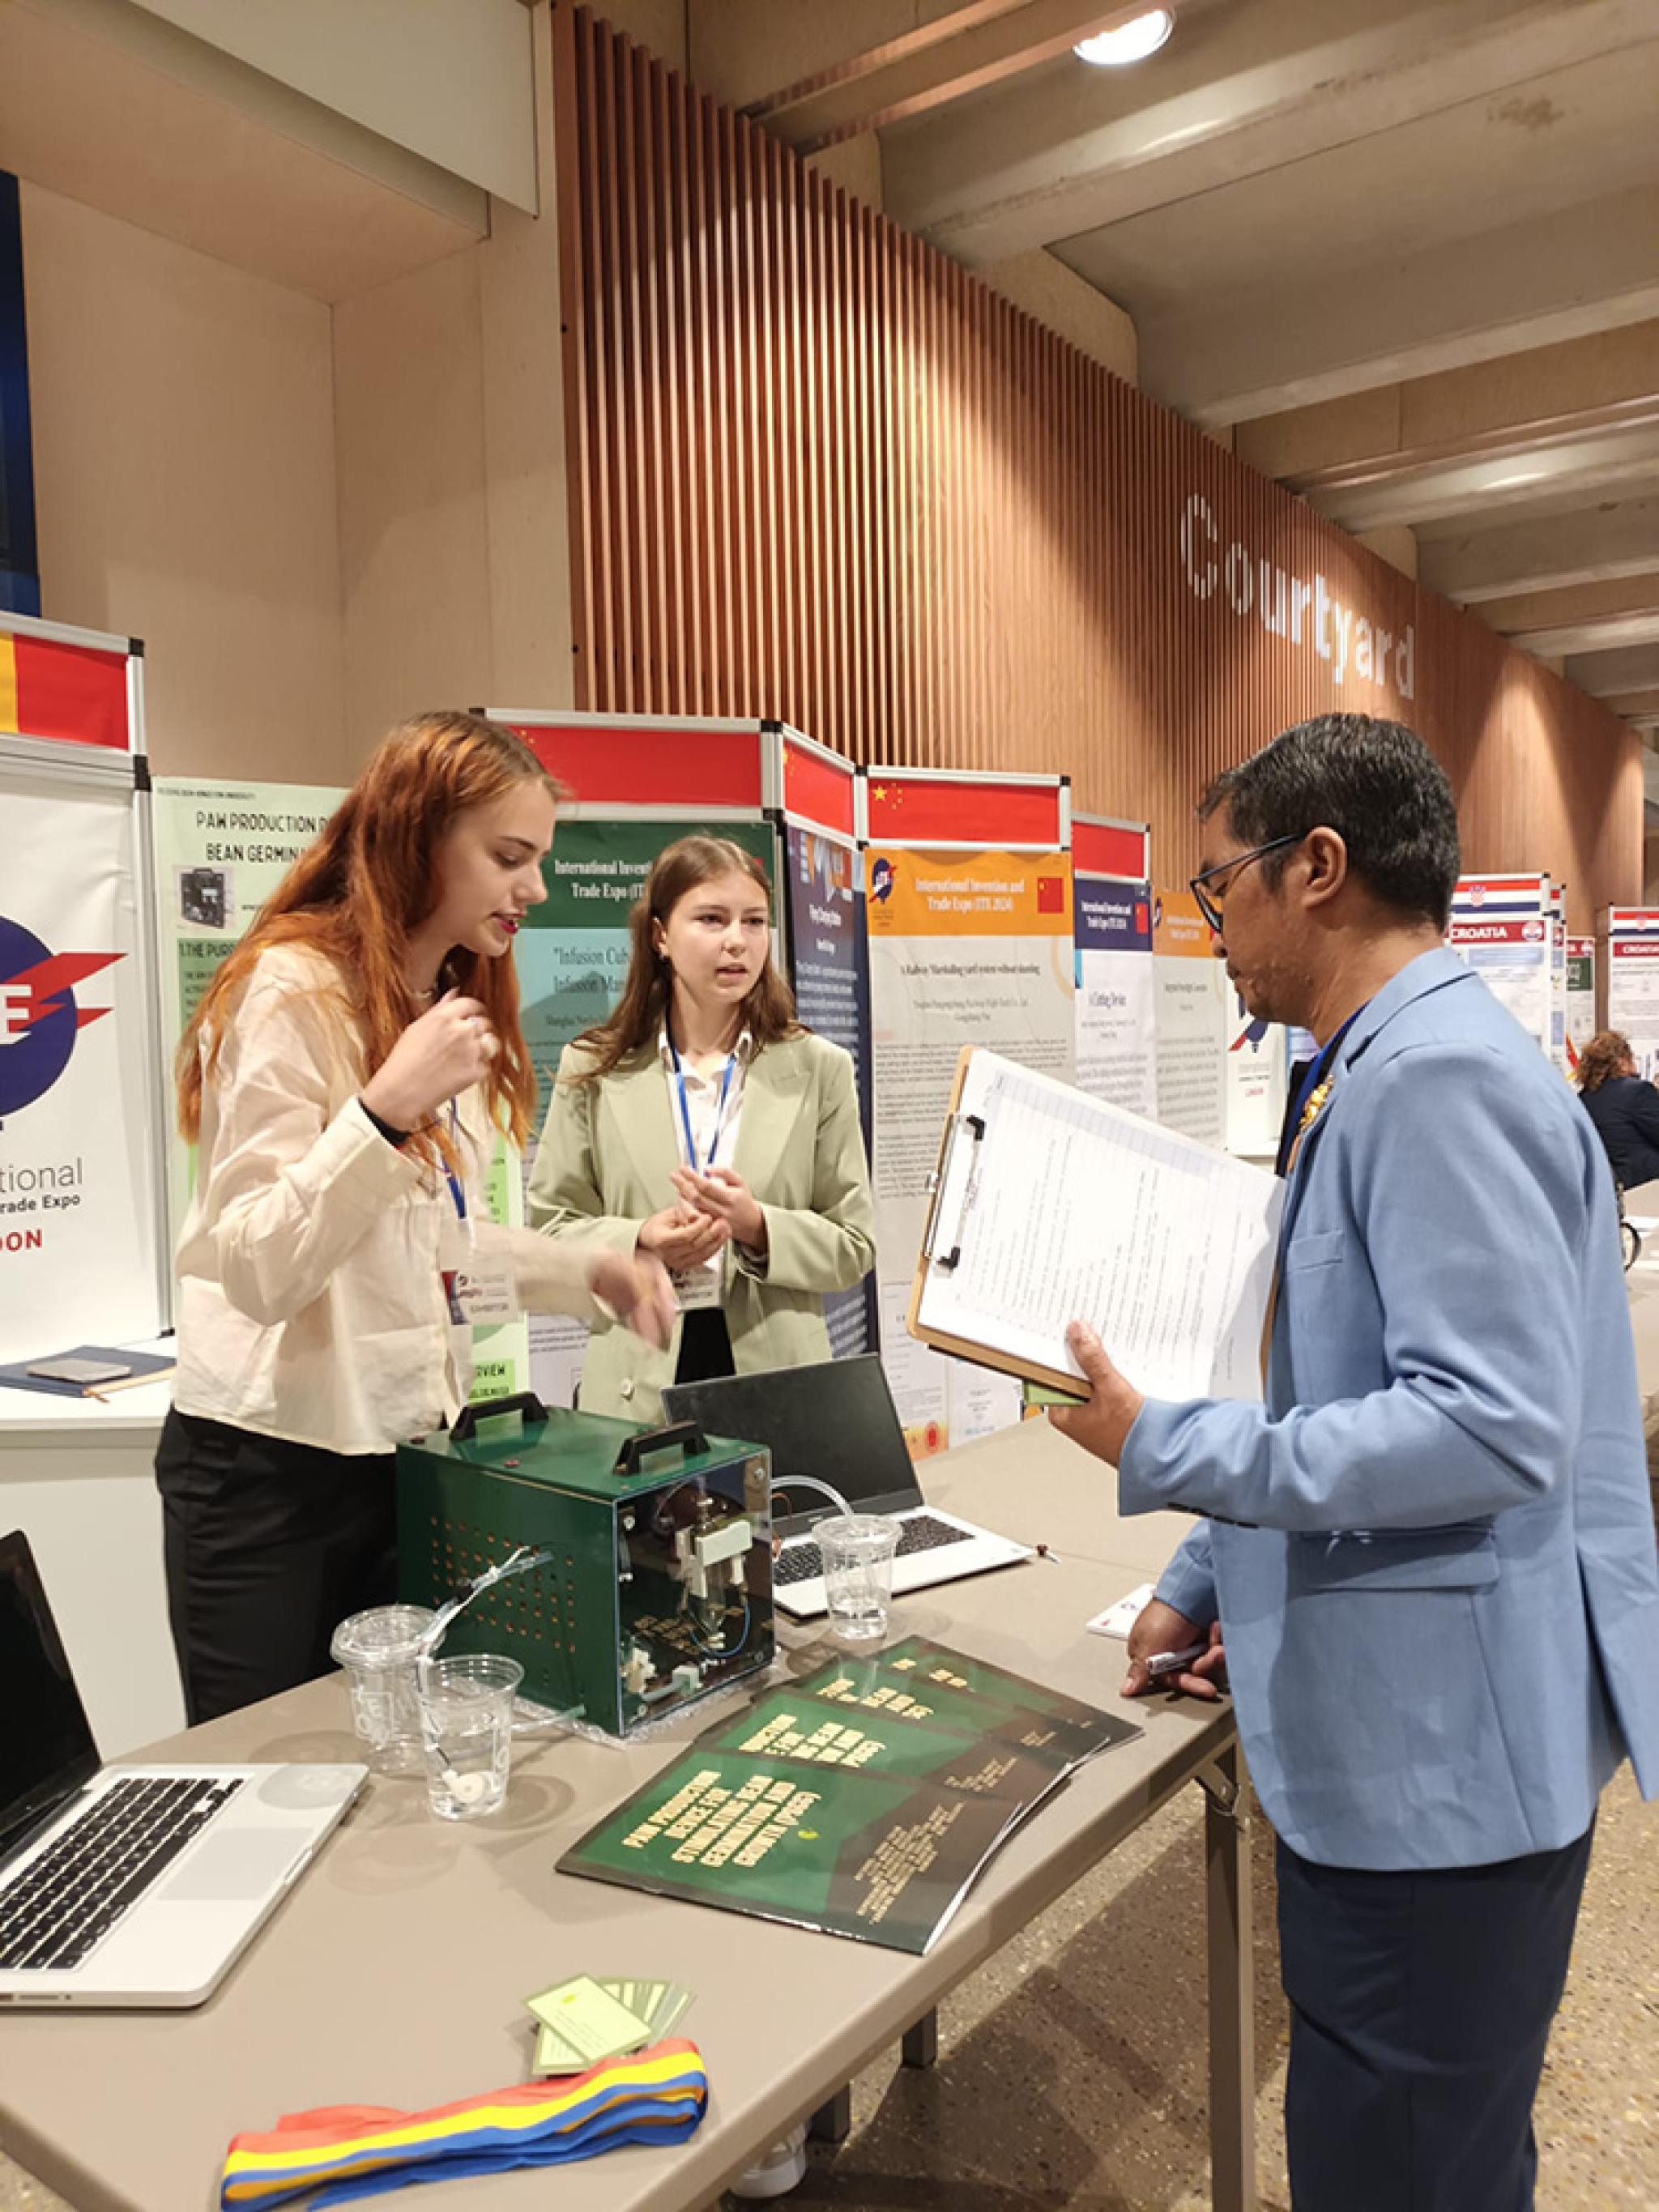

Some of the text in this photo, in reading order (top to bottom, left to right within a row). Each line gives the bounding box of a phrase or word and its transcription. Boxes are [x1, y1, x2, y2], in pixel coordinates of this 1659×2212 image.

[1180, 492, 1414, 700] Courtyard
[229, 813, 317, 833] PRODUCTION
[206, 842, 302, 863] BEAN GERMIN
[555, 859, 617, 876] International
[571, 882, 601, 899] Trade
[603, 882, 628, 903] Expo
[1451, 927, 1508, 940] CROATIA
[42, 1194, 80, 1210] Expo
[0, 1228, 43, 1252] ON
[647, 1769, 723, 1825] PRODUCTION
[736, 1774, 775, 1801] BEAN
